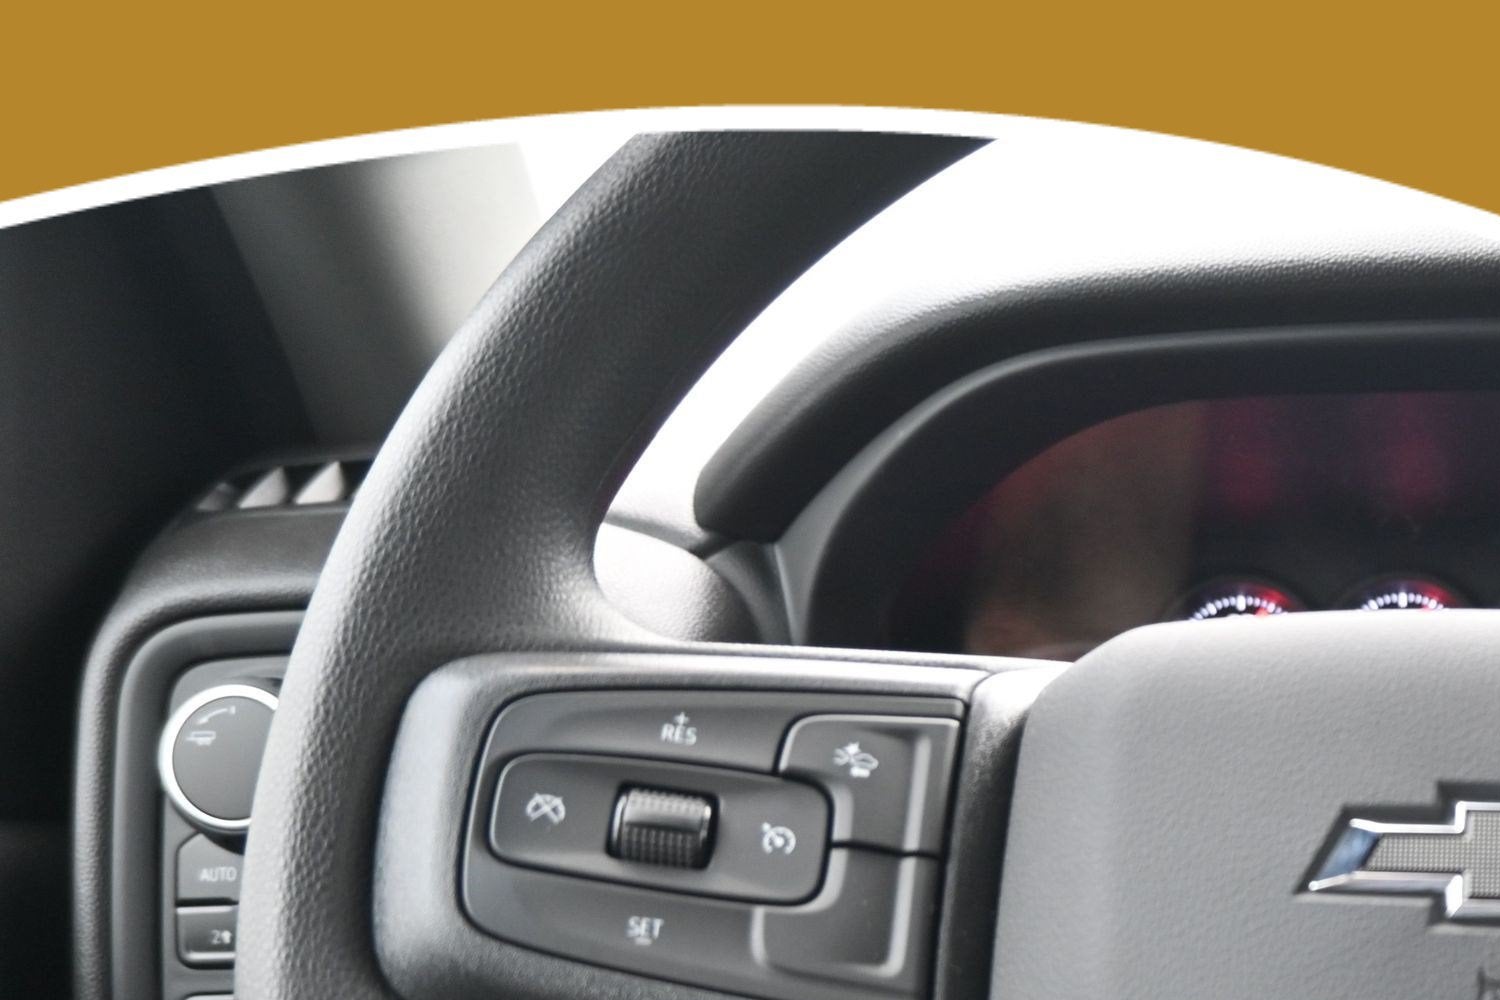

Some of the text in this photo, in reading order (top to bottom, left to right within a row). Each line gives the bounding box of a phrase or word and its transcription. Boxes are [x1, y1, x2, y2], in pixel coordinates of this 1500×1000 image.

[661, 722, 697, 746] RES
[200, 866, 238, 882] AUTO
[627, 915, 664, 938] SET
